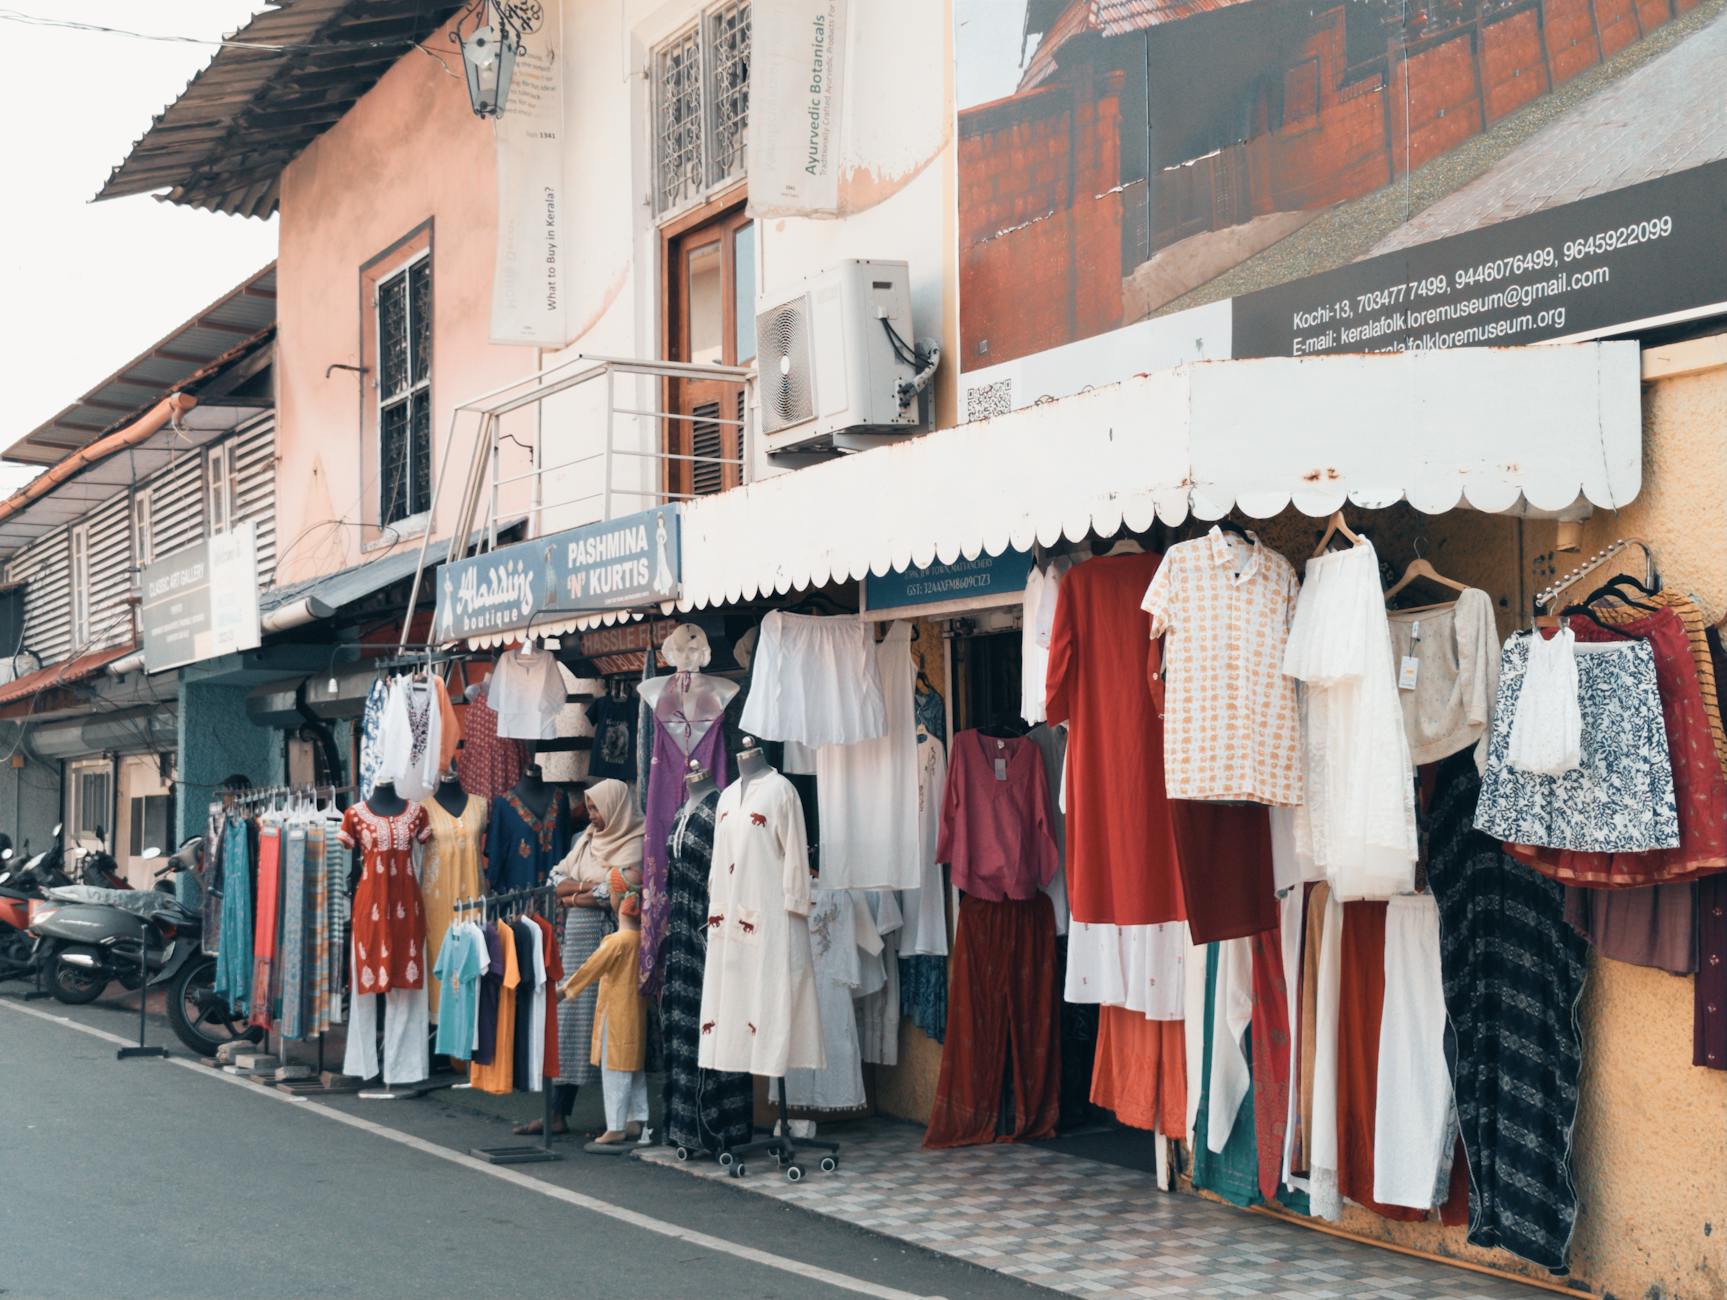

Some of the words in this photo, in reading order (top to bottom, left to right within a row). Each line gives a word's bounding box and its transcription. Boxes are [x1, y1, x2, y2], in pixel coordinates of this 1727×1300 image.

[810, 15, 825, 93] Botanicals
[826, 19, 834, 54] Products
[824, 55, 833, 94] Ayurvedic
[823, 95, 832, 127] Crafted
[805, 98, 821, 176] Ayurvedic
[545, 186, 555, 226] Kerala?
[546, 230, 555, 240] in
[547, 243, 559, 263] Buy
[548, 266, 556, 278] to
[1293, 300, 1354, 330] Kochi-13,
[1455, 247, 1559, 290] 9446076499,
[1563, 216, 1672, 261] 9645922099
[547, 281, 557, 311] What
[1293, 330, 1337, 356] E-mail:
[1341, 265, 1610, 344] keralafolkloremuseum@gmail.com
[568, 525, 648, 568] PASHMINA
[149, 576, 169, 598] CLASSIC
[170, 571, 181, 589] ART
[181, 563, 205, 586] GALLERY
[589, 558, 649, 595] KURTIS
[907, 583, 923, 597] GST:
[464, 608, 518, 631] boutique
[583, 628, 634, 656] HASSLE
